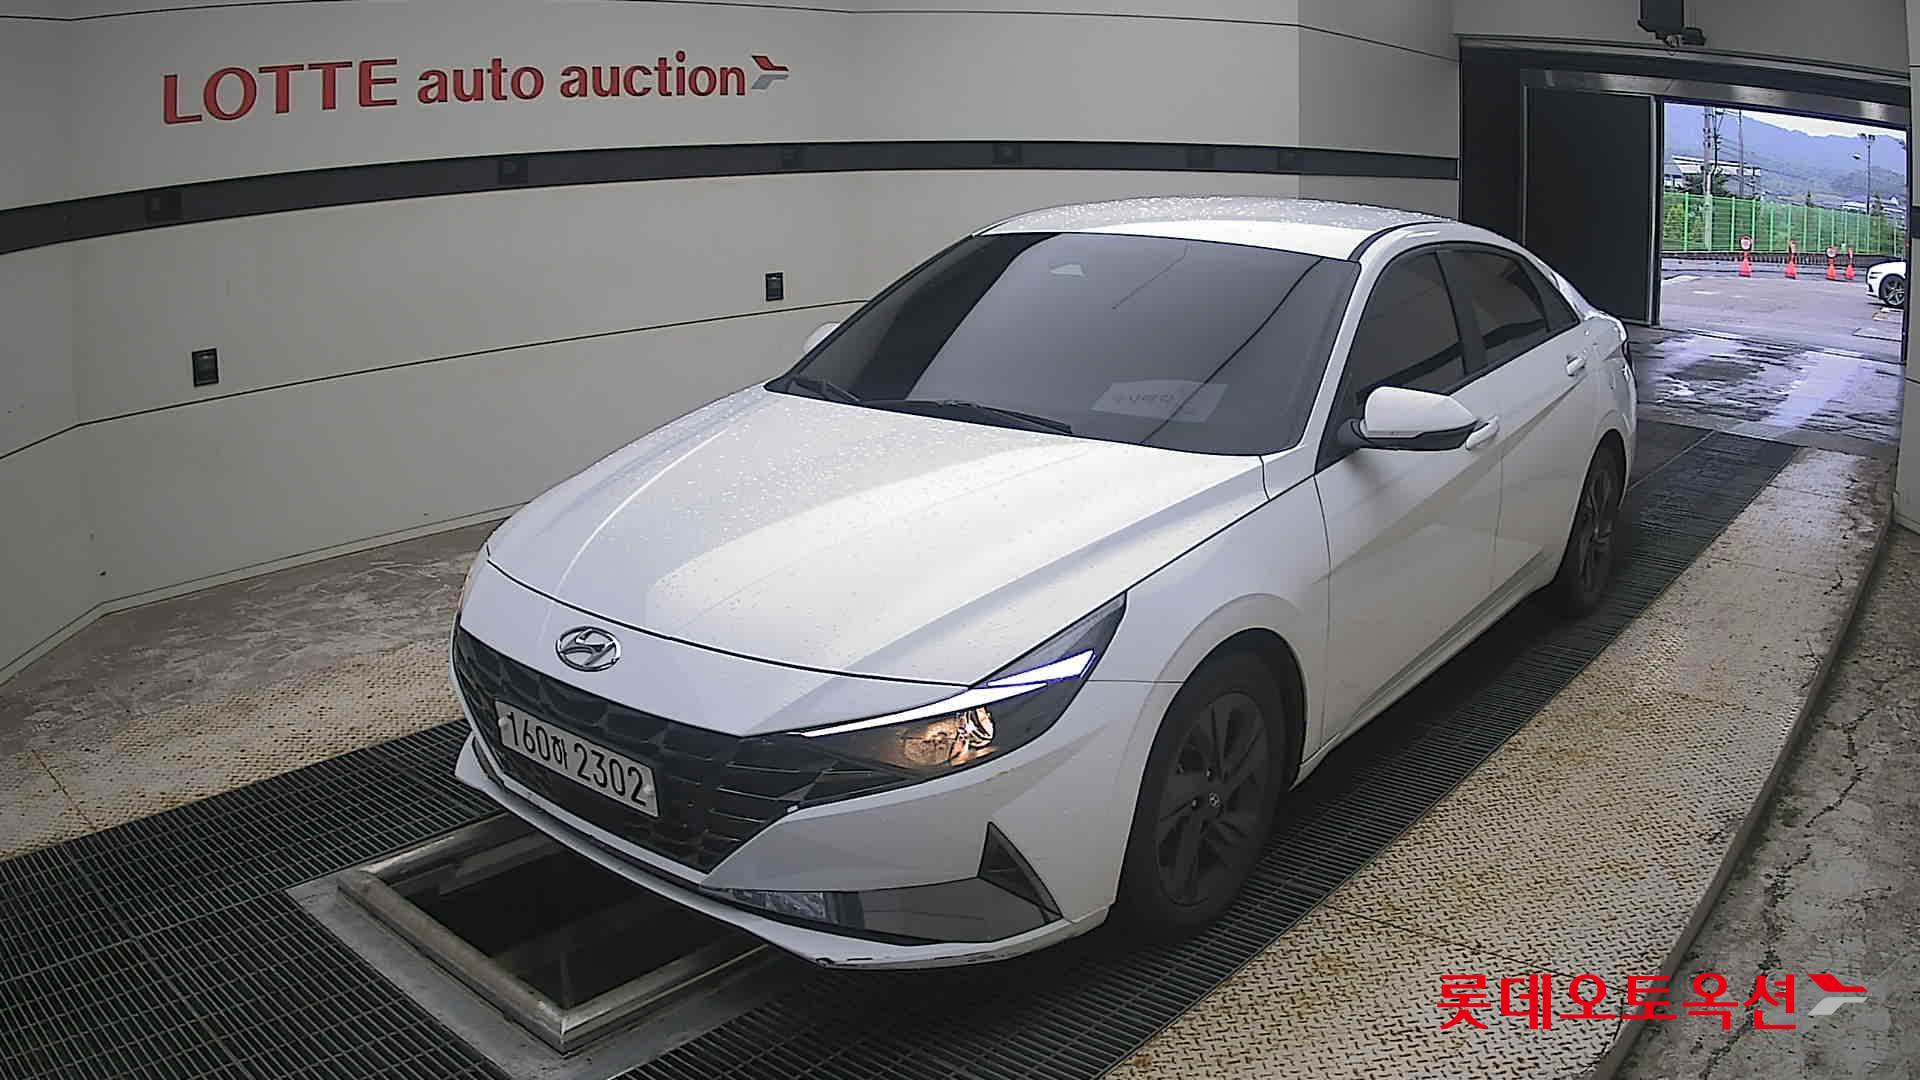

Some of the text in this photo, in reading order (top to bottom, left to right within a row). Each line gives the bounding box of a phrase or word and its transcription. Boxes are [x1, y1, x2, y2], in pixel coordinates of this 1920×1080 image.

[163, 51, 747, 124] LOTTE auto auction
[507, 711, 646, 806] 160하 2302
